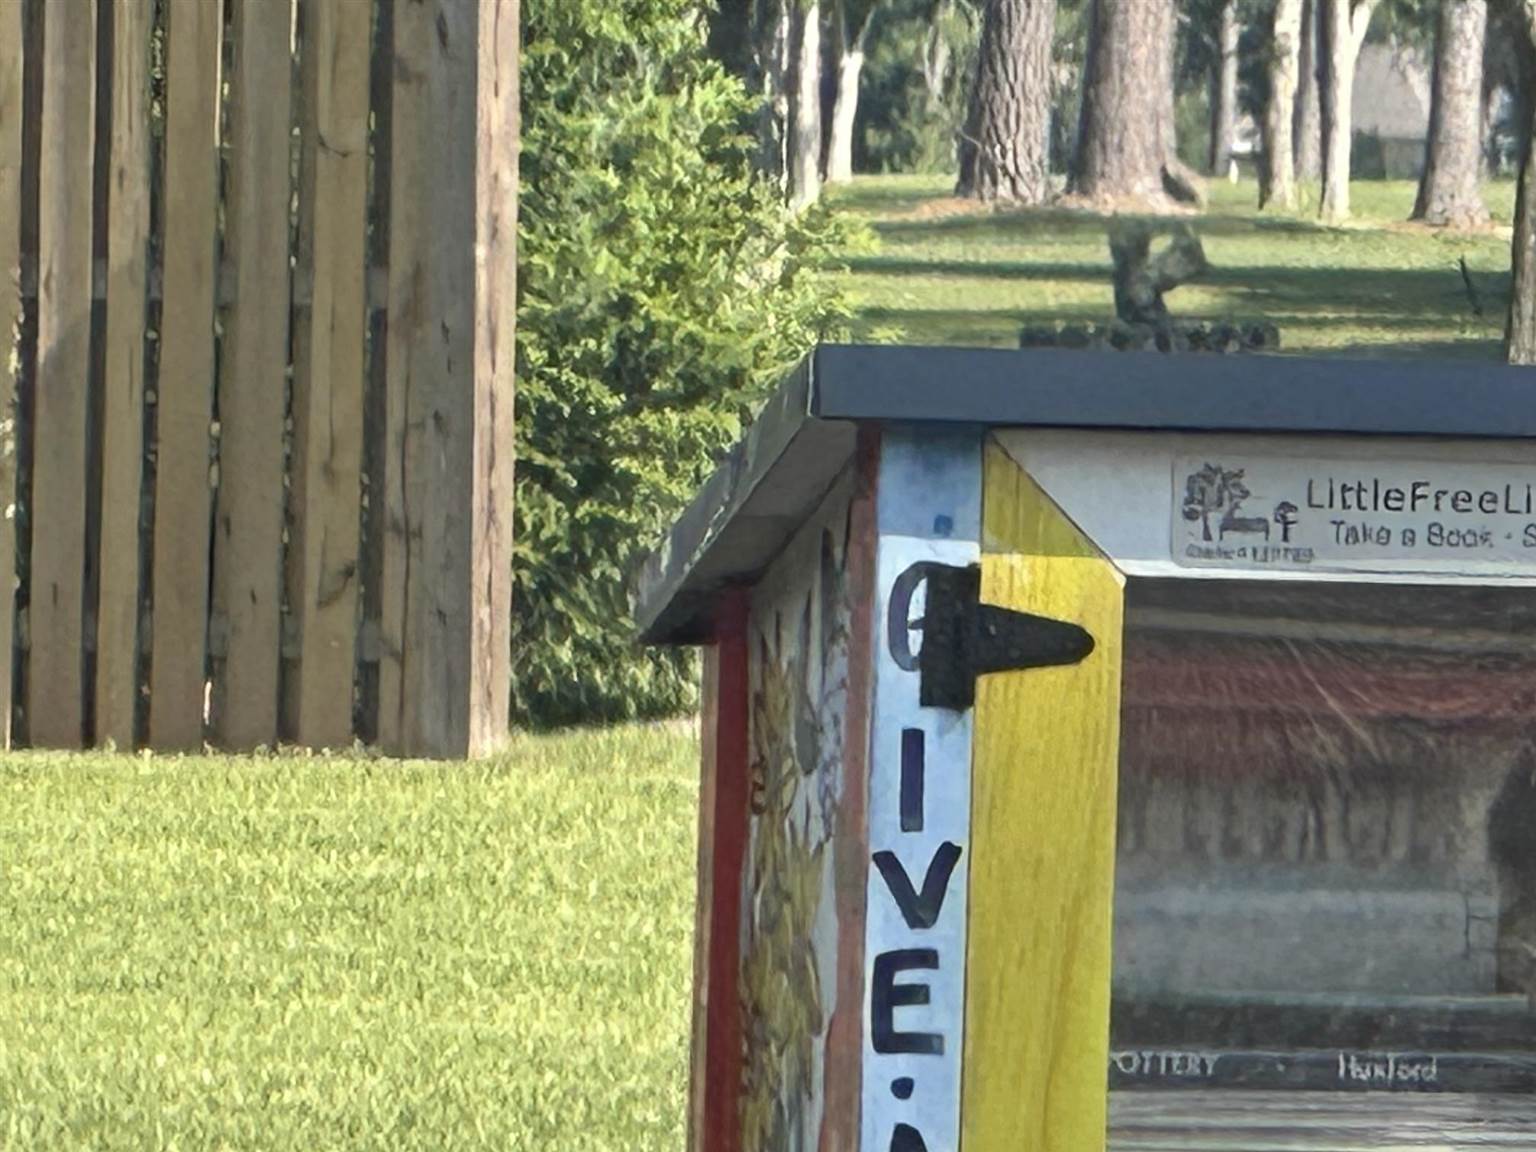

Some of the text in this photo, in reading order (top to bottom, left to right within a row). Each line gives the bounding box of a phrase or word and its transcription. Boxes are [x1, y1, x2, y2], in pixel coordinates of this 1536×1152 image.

[1330, 520, 1392, 548] Take
[1401, 527, 1417, 548] a
[1427, 521, 1494, 549] Book
